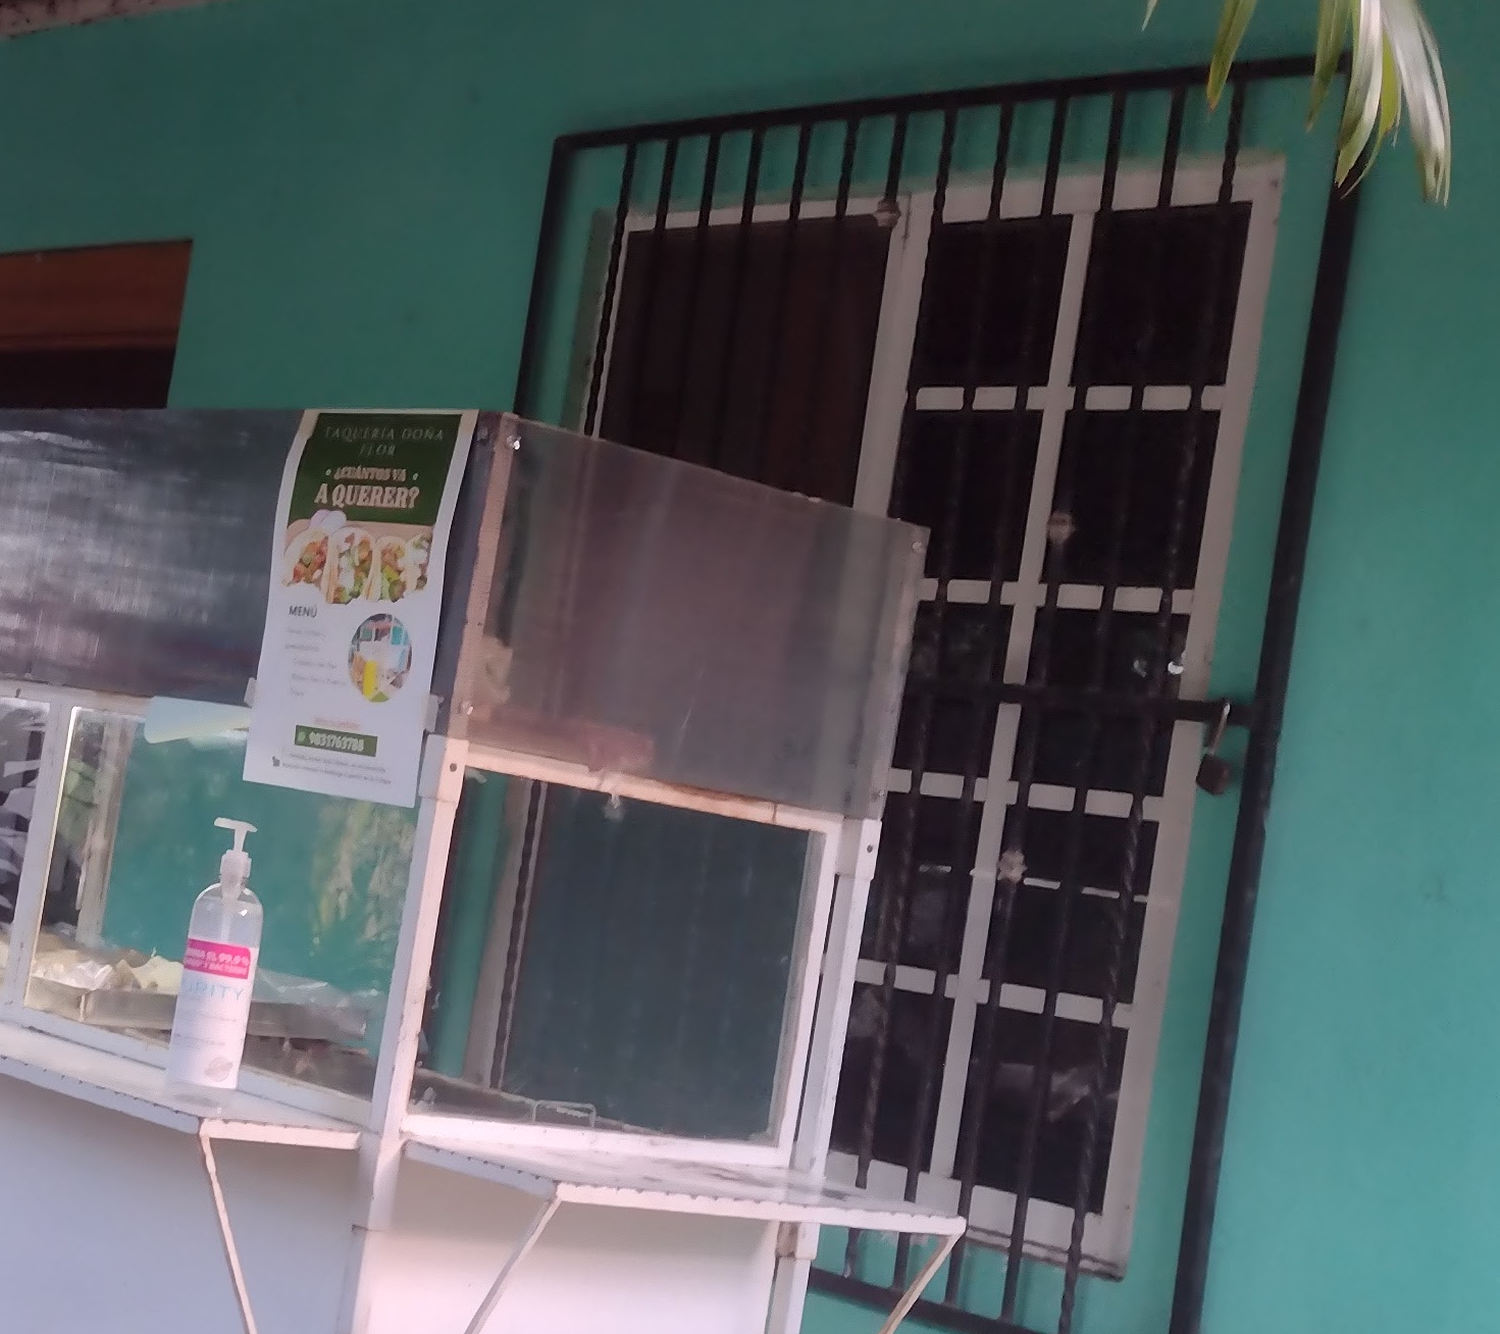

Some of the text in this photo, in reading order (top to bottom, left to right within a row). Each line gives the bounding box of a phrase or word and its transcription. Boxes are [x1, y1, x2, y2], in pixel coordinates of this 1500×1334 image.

[314, 483, 420, 508] A QUERER?
[288, 604, 317, 618] MENÚ
